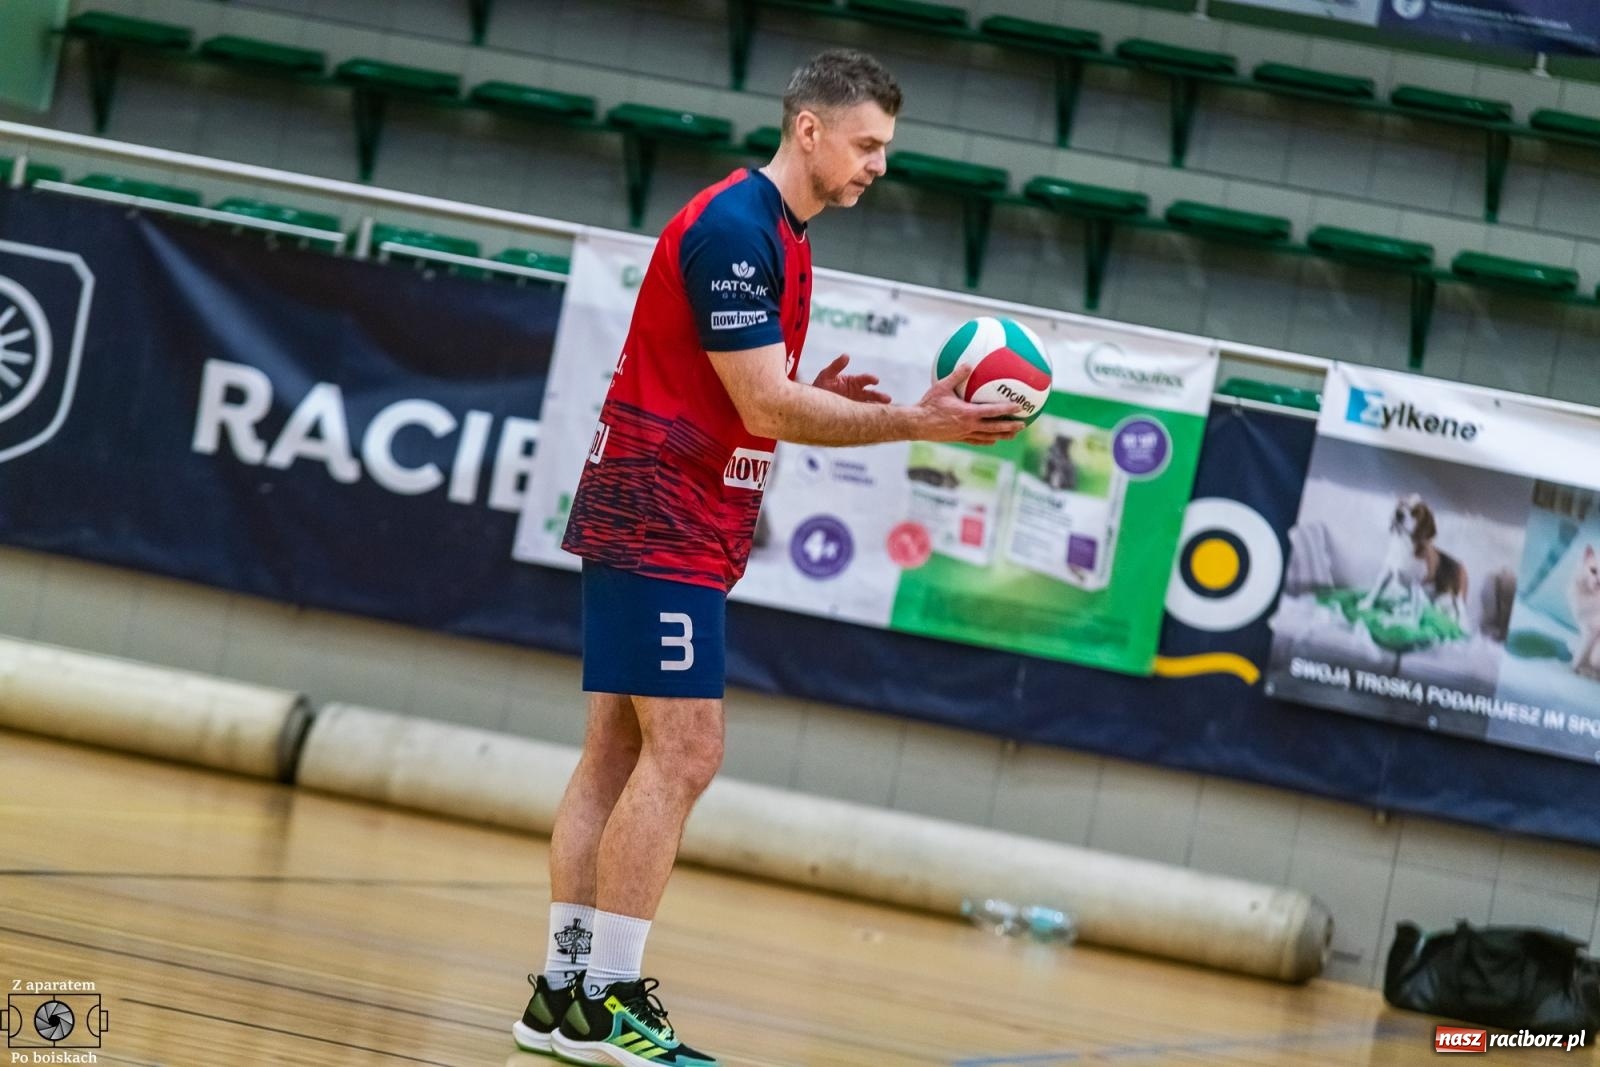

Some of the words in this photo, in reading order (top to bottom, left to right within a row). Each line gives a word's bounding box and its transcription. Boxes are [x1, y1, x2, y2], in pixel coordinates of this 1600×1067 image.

[711, 280, 769, 297] KATOLIK
[996, 384, 1036, 414] molten
[659, 612, 695, 671] 3
[1543, 709, 1565, 731] IM
